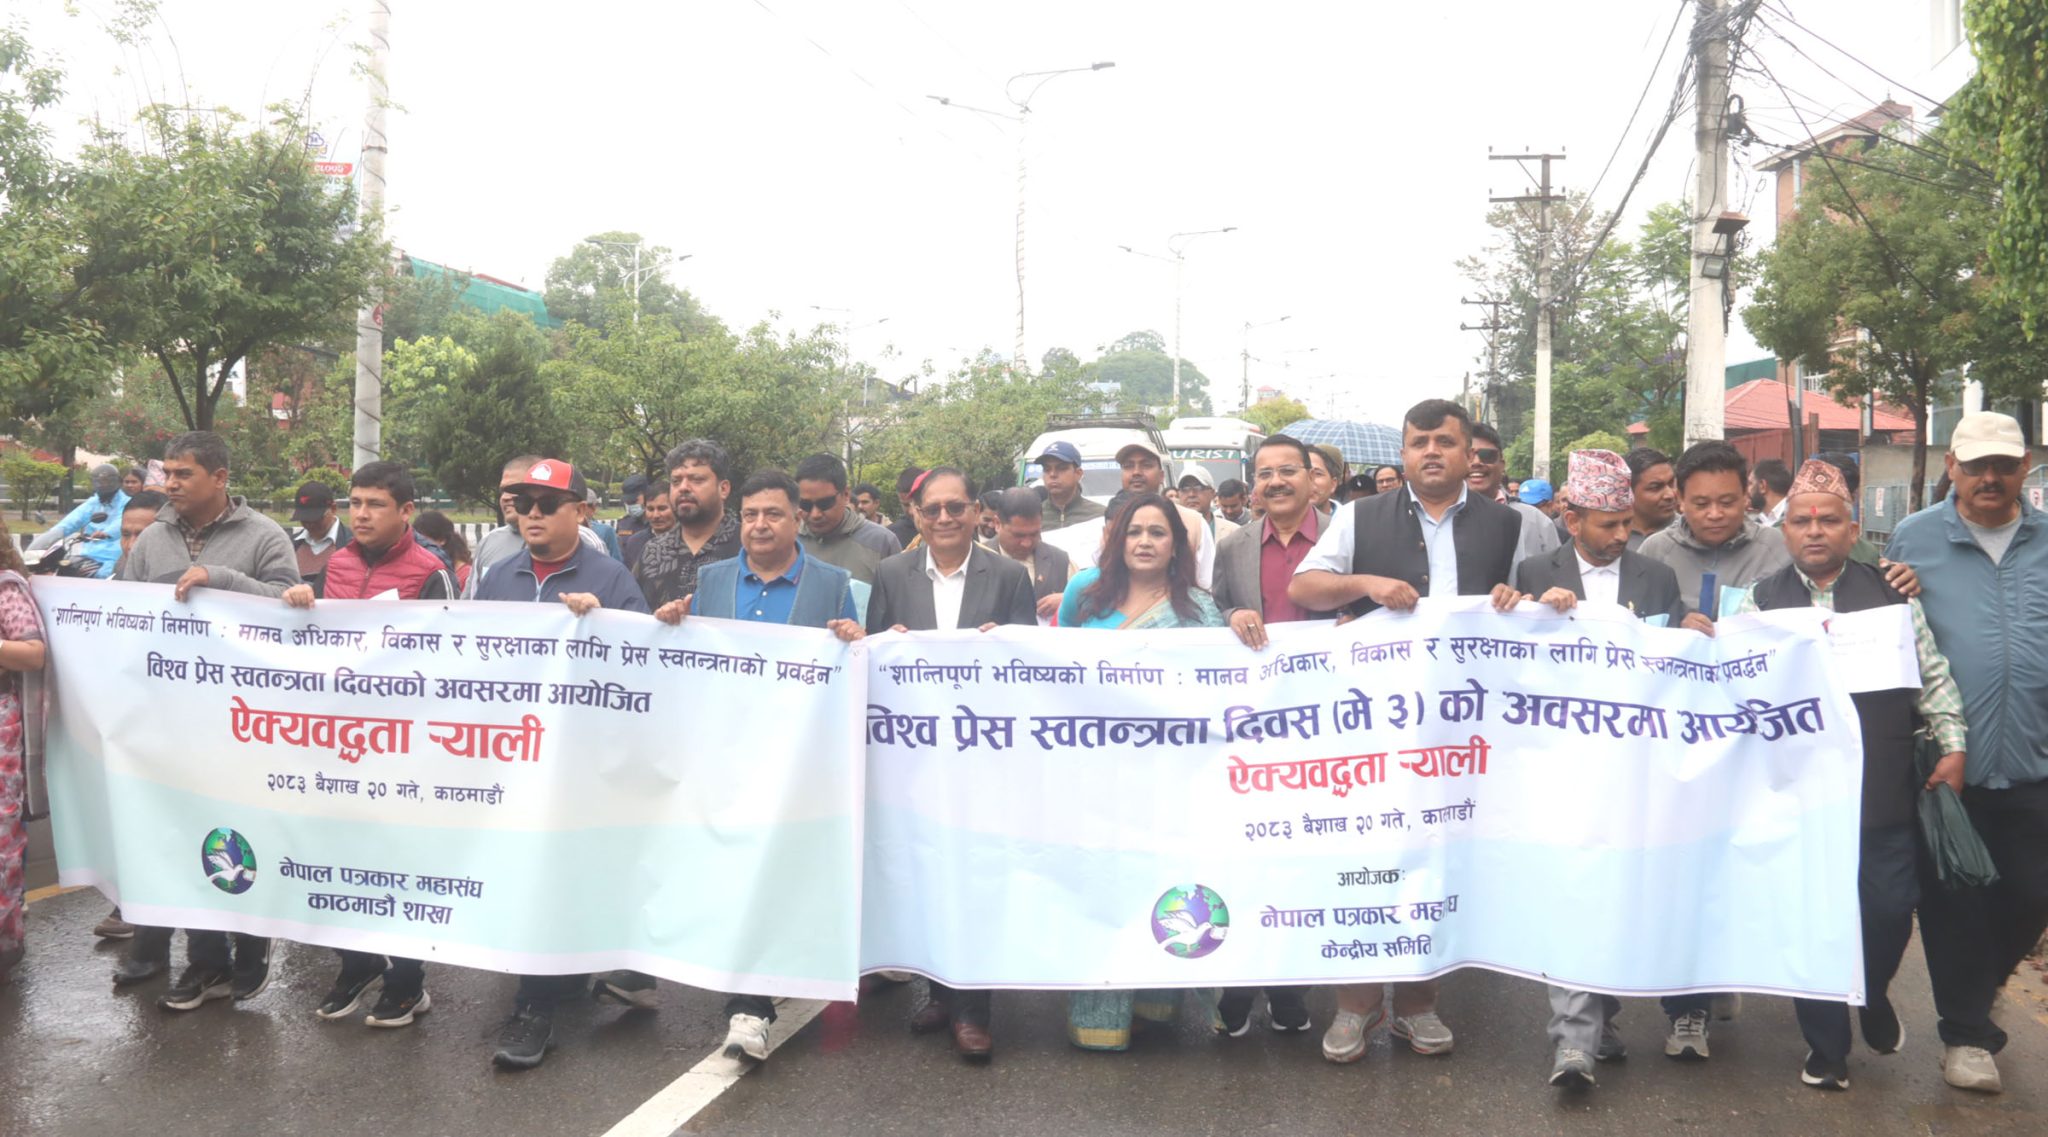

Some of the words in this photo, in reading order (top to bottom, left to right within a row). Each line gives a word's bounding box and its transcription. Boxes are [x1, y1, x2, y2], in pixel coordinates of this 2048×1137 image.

[1173, 449, 1237, 459] URIST
[106, 609, 154, 633] भविष्यको
[162, 613, 211, 638] निर्माण
[239, 624, 283, 645] मानव
[292, 624, 368, 652] अधिकार,
[382, 625, 441, 652] विकास
[453, 637, 466, 656] र
[476, 635, 557, 659] सुरक्षाका
[566, 634, 612, 661] लागि
[621, 641, 650, 666] प्रेस
[658, 649, 768, 678] स्वतन्त्रताको
[992, 660, 1087, 686] भविष्यको
[1098, 660, 1164, 686] निर्माण
[1195, 666, 1249, 687] मानव
[1259, 651, 1336, 682] अधिकार,
[1350, 637, 1413, 667] विकास
[1425, 636, 1441, 661] र
[1450, 636, 1537, 665] सुरक्षाका
[1549, 637, 1598, 666] लागि
[1605, 639, 1636, 672] प्रेस
[147, 652, 187, 681] विश्व
[195, 656, 224, 684] प्रेस
[231, 665, 325, 692] स्वतन्त्रता
[334, 667, 426, 698] दिवसको
[435, 677, 541, 703] अवसरमा
[547, 679, 653, 714] आयोजित
[866, 703, 940, 748] विश्व
[952, 704, 1016, 752] प्रेस
[1030, 716, 1210, 751] स्वतन्त्रता
[1223, 704, 1321, 744] दिवस
[1439, 678, 1489, 723] को
[1502, 689, 1668, 741] अवसरमा
[267, 773, 306, 794] २०८३
[367, 781, 387, 800] २०
[1245, 820, 1293, 841] २०८३
[1356, 815, 1373, 834] २०
[279, 856, 333, 884] नेपाल
[341, 866, 409, 892] पत्रकार
[416, 874, 484, 899] महासंघ
[403, 901, 453, 925] शाखा
[1261, 905, 1324, 928] नेपाल
[1333, 905, 1401, 926] पत्रकार
[1321, 939, 1378, 960] केन्द्रीय
[1382, 934, 1432, 957] समिति
